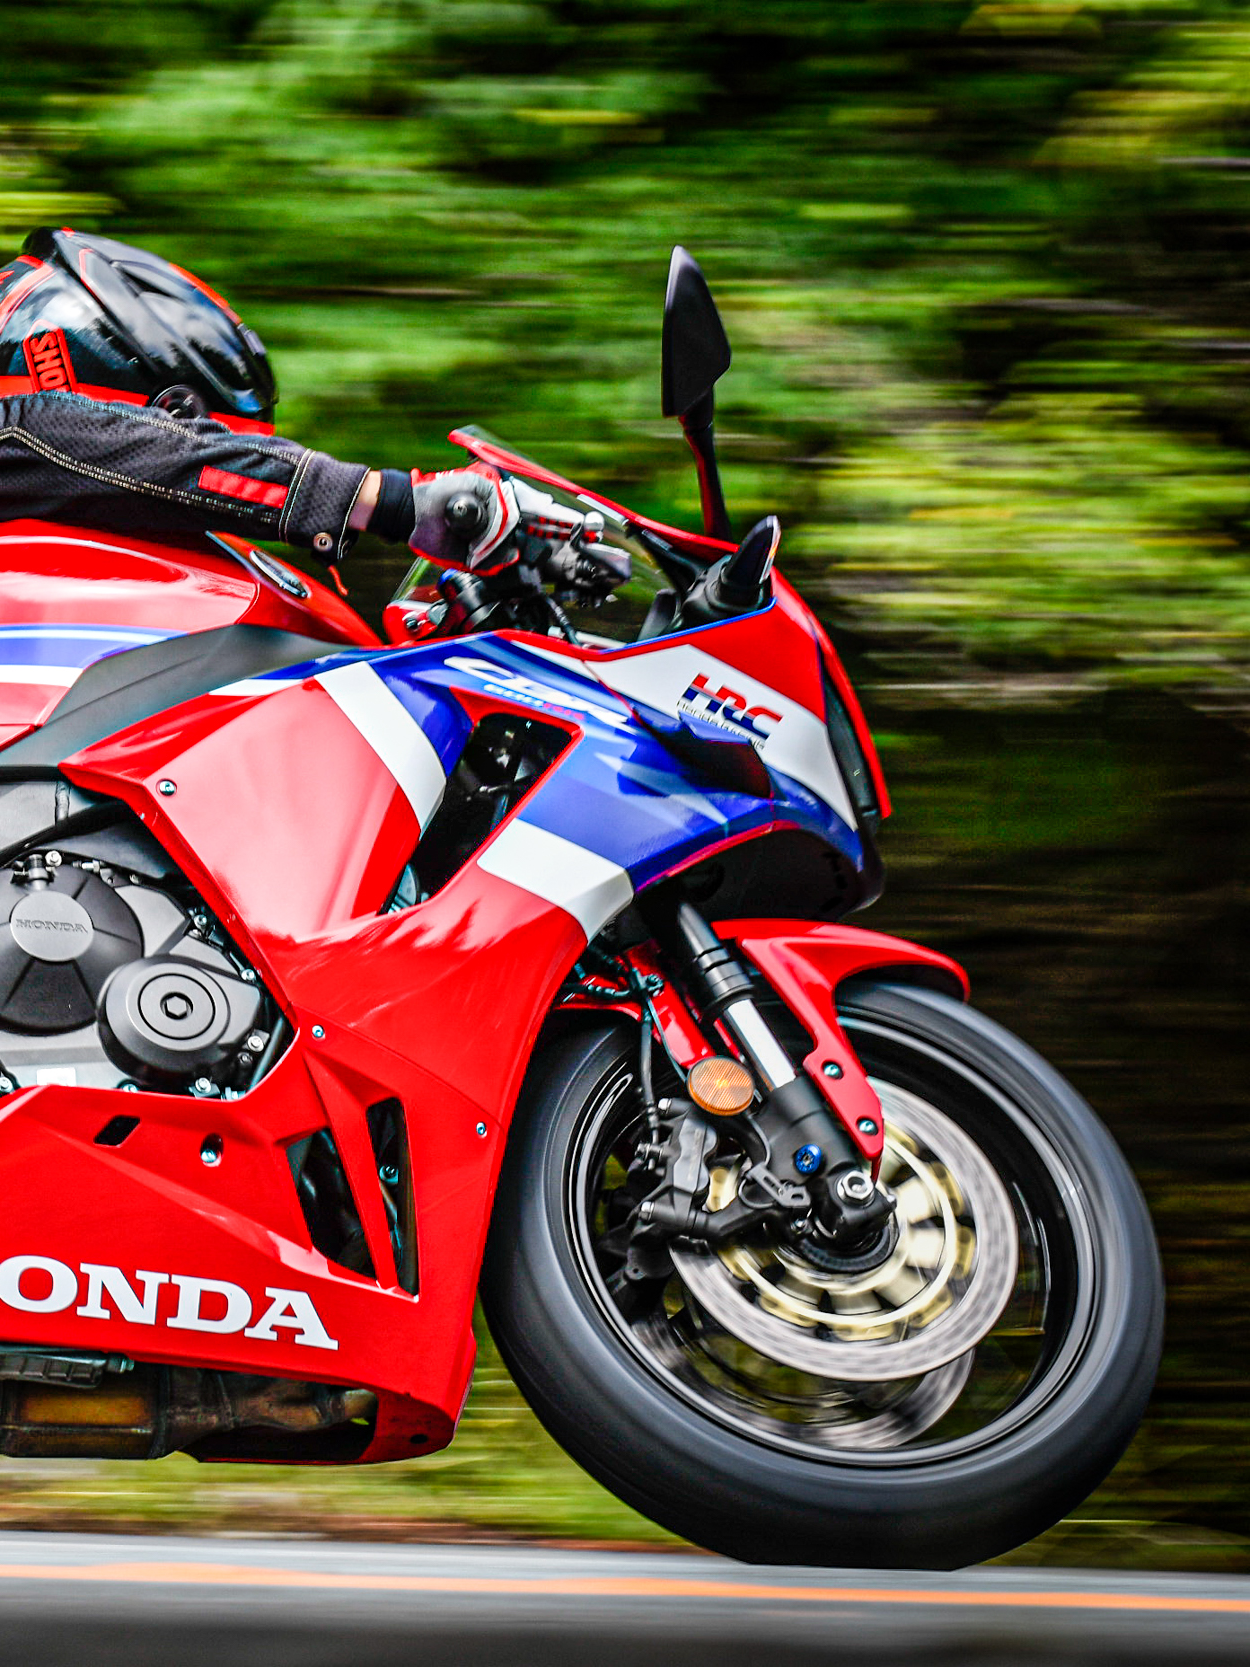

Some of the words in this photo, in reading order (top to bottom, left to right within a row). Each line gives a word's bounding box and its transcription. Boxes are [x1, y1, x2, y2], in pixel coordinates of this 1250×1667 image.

[30, 331, 70, 392] SHO
[681, 673, 784, 740] HRC
[15, 918, 89, 934] HONDA
